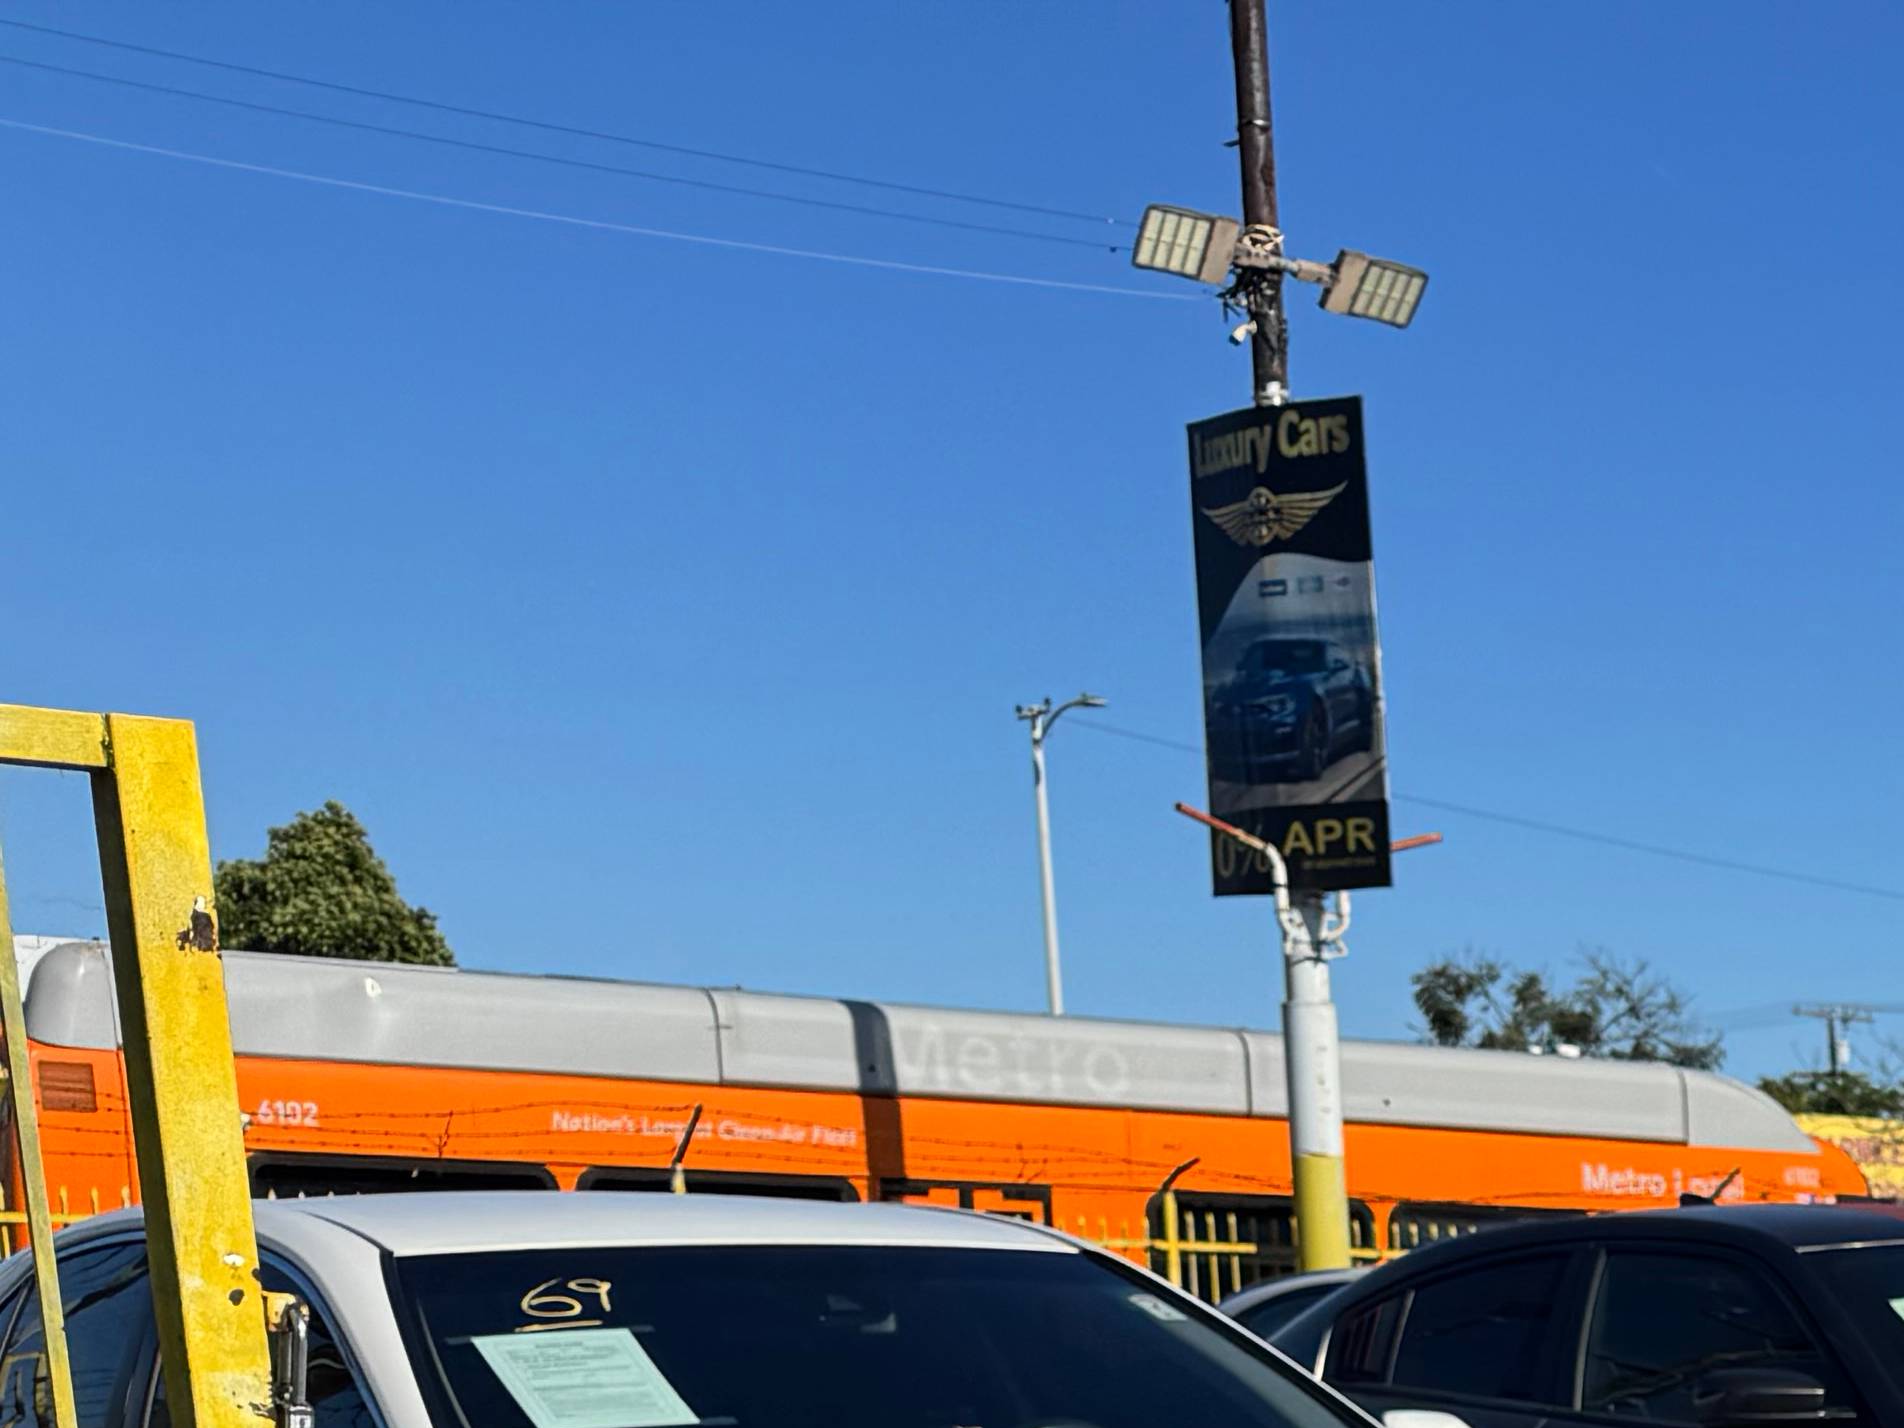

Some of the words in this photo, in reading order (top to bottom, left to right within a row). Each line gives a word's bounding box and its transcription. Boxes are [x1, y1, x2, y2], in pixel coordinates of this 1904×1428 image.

[1277, 408, 1350, 460] Cars
[1281, 816, 1377, 857] APR
[258, 1098, 320, 1128] 6102
[1580, 1161, 1666, 1197] Metro
[521, 1277, 612, 1318] 69
